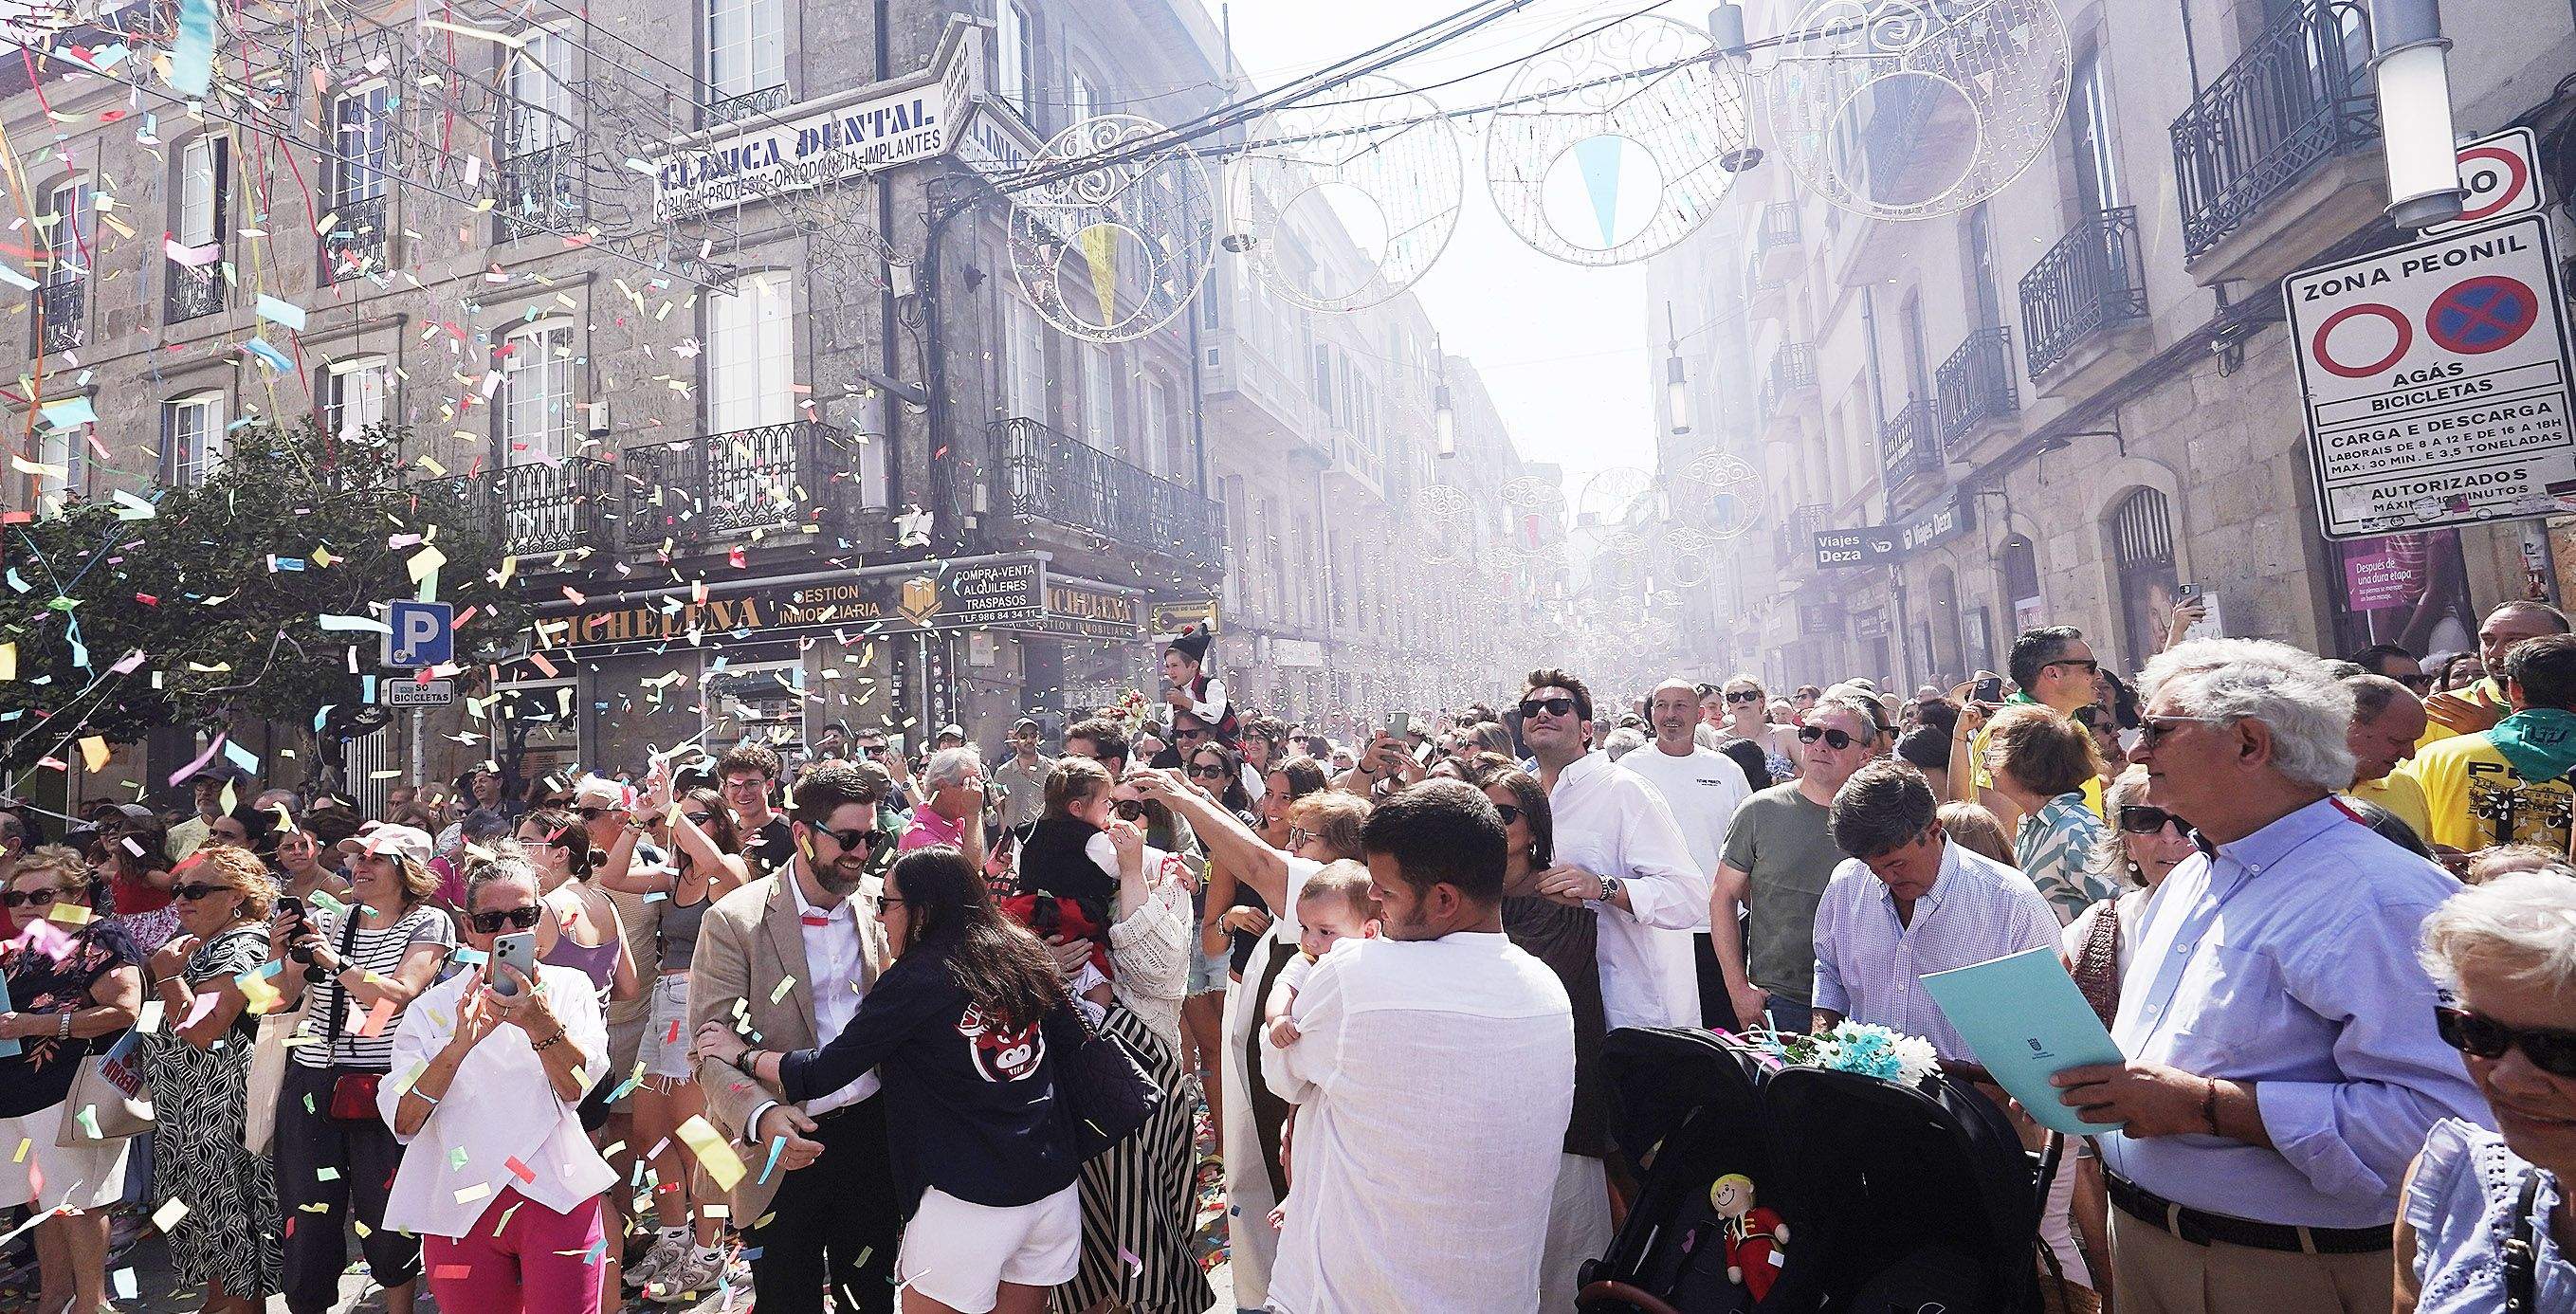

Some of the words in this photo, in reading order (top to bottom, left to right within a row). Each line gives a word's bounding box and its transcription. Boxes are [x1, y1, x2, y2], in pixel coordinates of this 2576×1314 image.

[797, 98, 935, 158] DENTAL
[2303, 267, 2391, 301] ZONA
[2402, 234, 2528, 278] PEONIL
[2392, 362, 2464, 387] AGÁS
[2371, 379, 2494, 411] BICICLETAS
[2330, 428, 2401, 447] CARGA
[2407, 424, 2420, 435] E
[2427, 402, 2552, 431] DESCARGA
[2329, 446, 2392, 463] LABORAIS
[2397, 442, 2413, 451] DE
[2419, 440, 2427, 448] 8
[2433, 438, 2441, 447] A
[2446, 435, 2458, 444] 12
[2464, 432, 2473, 441] E
[2477, 429, 2495, 439] DE
[2501, 426, 2515, 435] 16
[2521, 423, 2531, 432] A
[2535, 418, 2562, 429] 18H
[2369, 458, 2385, 468] 30
[2425, 451, 2435, 460] E
[2439, 447, 2461, 459] 3,5
[2467, 431, 2563, 454] TONELADAS
[2371, 468, 2528, 501] AUTORIZADOS
[2373, 499, 2414, 513] MÁXI
[2467, 484, 2530, 501] INUTOS
[1818, 535, 1860, 549] Viajes
[1818, 550, 1861, 563] Deza
[2356, 559, 2385, 574] Después
[2385, 557, 2396, 568] de
[956, 564, 1034, 581] COMPRA-VENTA
[2358, 575, 2371, 585] una
[2372, 572, 2389, 583] dura
[2389, 570, 2412, 581] etapa
[963, 579, 1028, 595] ALQUILERES
[779, 602, 882, 625] INMOLIARIA
[965, 593, 1027, 610] TRASPASOS
[997, 611, 1009, 619] 84
[1011, 610, 1023, 618] 34
[1025, 609, 1035, 617] 11
[1047, 587, 1131, 621] ICHELENA
[405, 610, 439, 658] P
[393, 693, 449, 703] BICICLETAS
